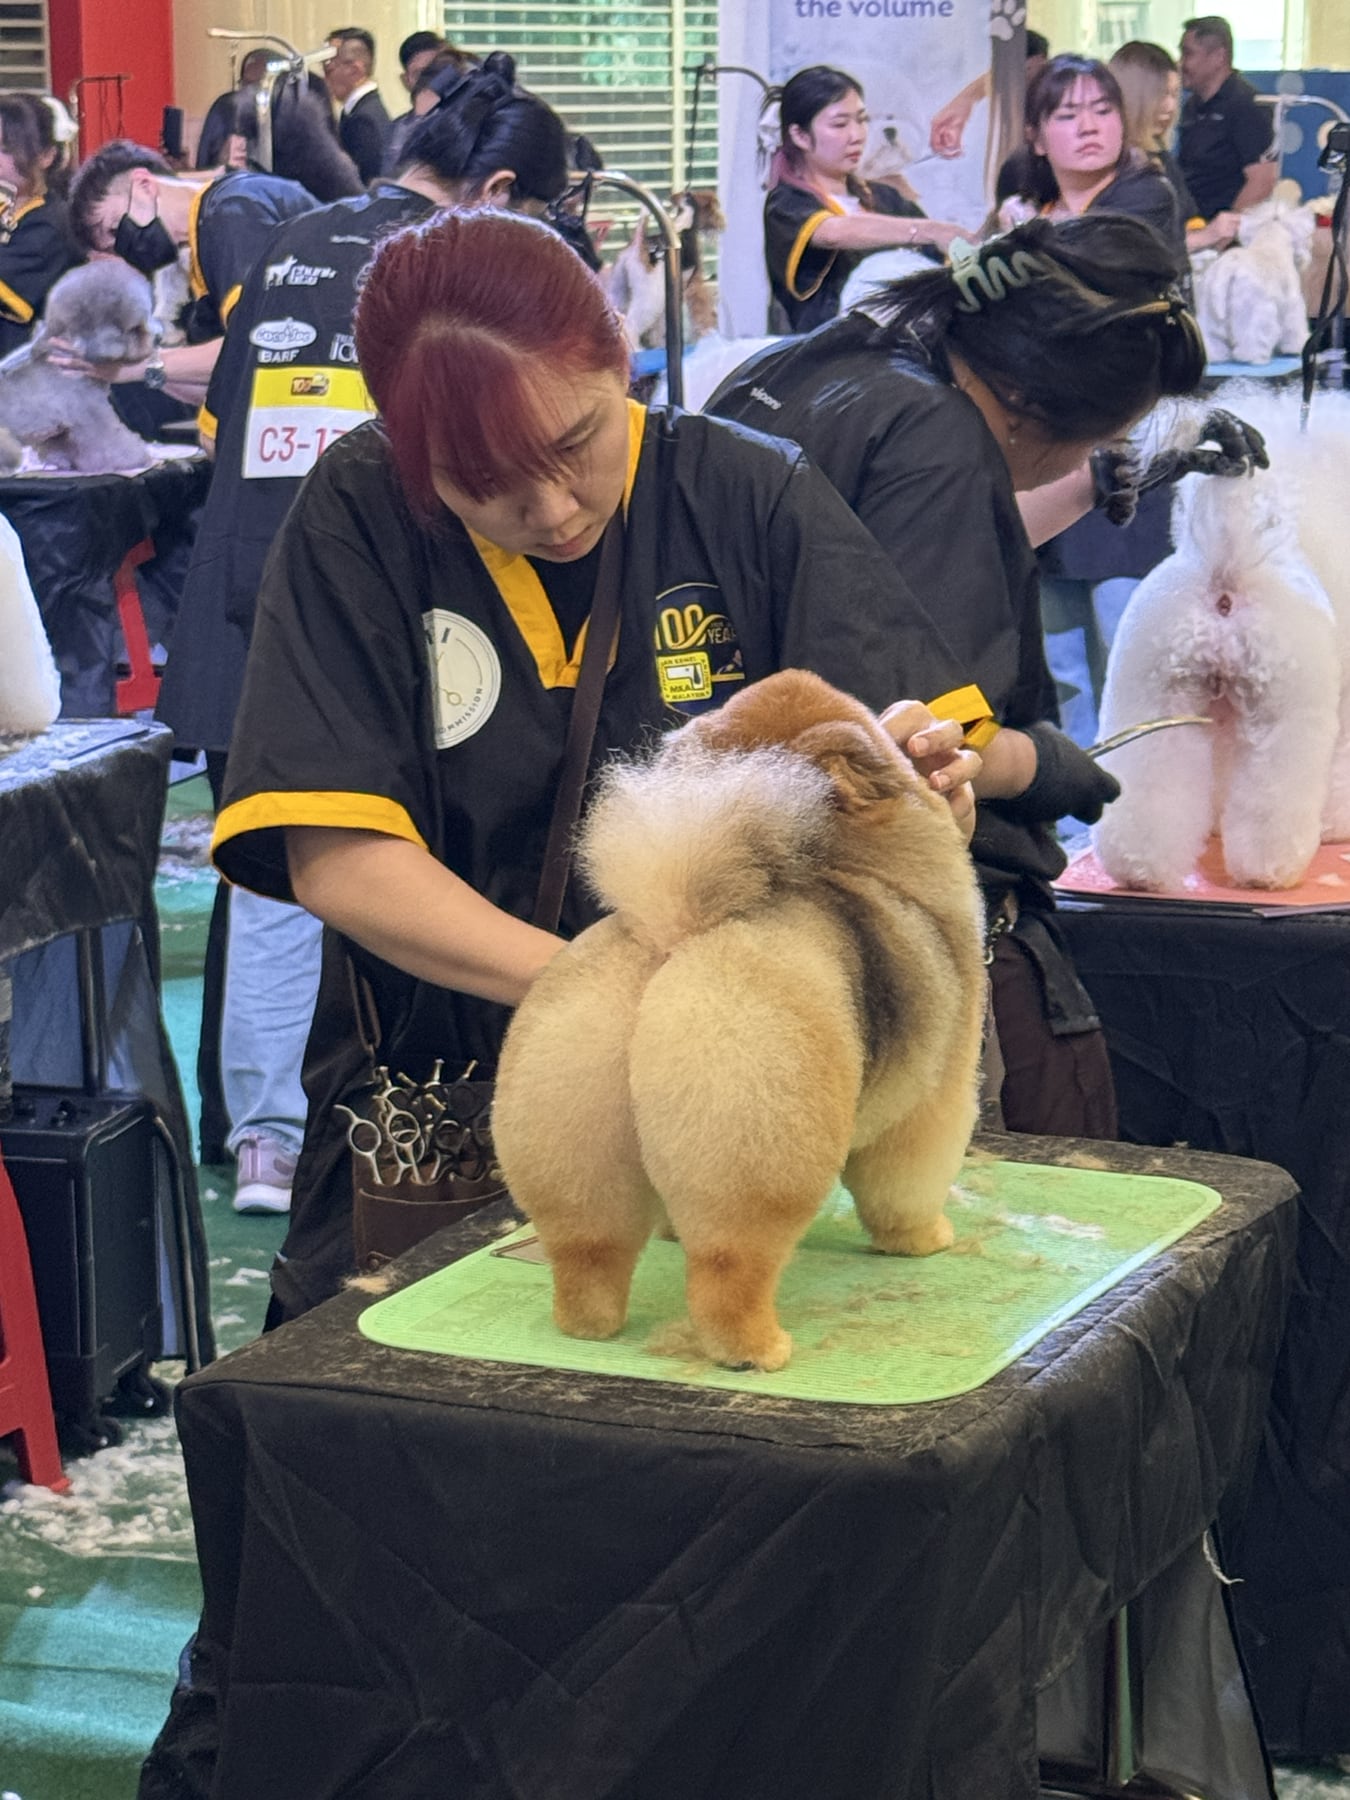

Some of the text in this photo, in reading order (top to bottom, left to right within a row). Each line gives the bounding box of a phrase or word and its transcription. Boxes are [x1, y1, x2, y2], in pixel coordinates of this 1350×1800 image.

[796, 0, 954, 17] the volume
[258, 349, 299, 362] BARF
[438, 687, 483, 734] OMMISSION
